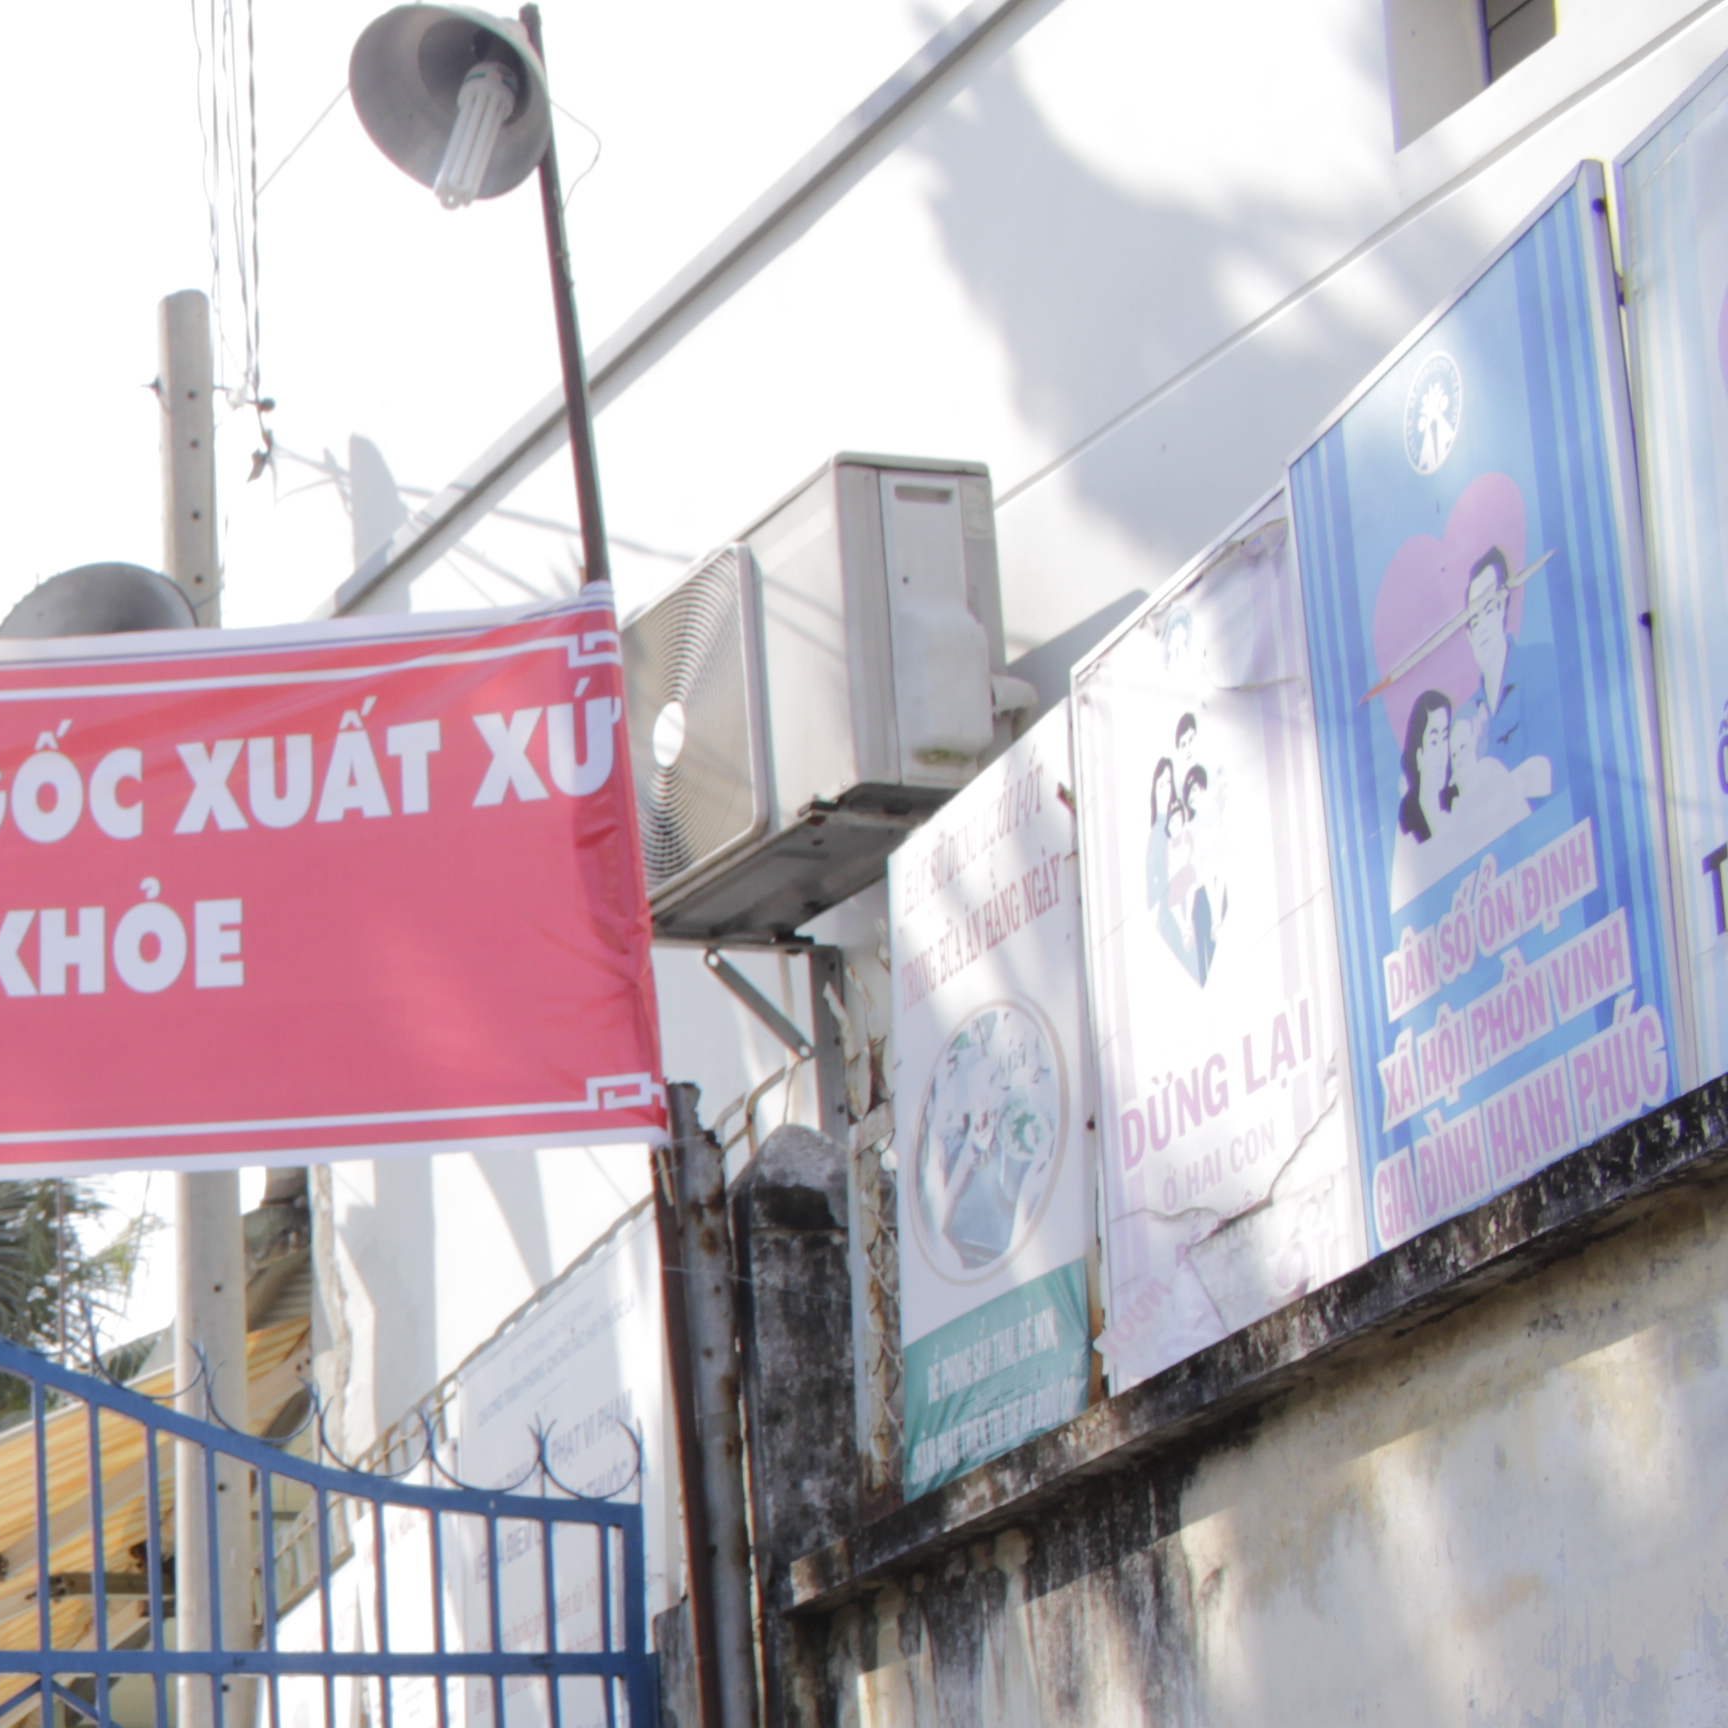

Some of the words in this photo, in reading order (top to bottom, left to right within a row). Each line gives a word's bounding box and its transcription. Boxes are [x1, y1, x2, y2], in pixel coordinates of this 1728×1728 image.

[174, 696, 440, 836] XUẤT
[473, 676, 622, 808] XỨ
[901, 945, 937, 1013] TRONG
[1021, 846, 1060, 924] NGÀY
[1388, 937, 1435, 1012] DÂN
[1441, 884, 1473, 975] SỐ
[1478, 863, 1516, 949] ỔN
[1520, 831, 1591, 926] ĐỊNH
[1121, 1053, 1229, 1172] DỪNG
[1242, 998, 1312, 1095] LẠI
[1383, 1042, 1415, 1122] XÃ
[1420, 1013, 1467, 1105] HỘI
[1471, 958, 1546, 1067] PHỒN
[1552, 917, 1626, 1014] VINH
[1163, 1162, 1178, 1211] Ở
[1185, 1152, 1222, 1201] HAI
[1229, 1117, 1276, 1174] CON
[1377, 1159, 1416, 1242] GIA
[1418, 1119, 1486, 1219] ĐÌNH
[1488, 1066, 1570, 1184] HẠNH
[1572, 1001, 1663, 1134] PHÚC
